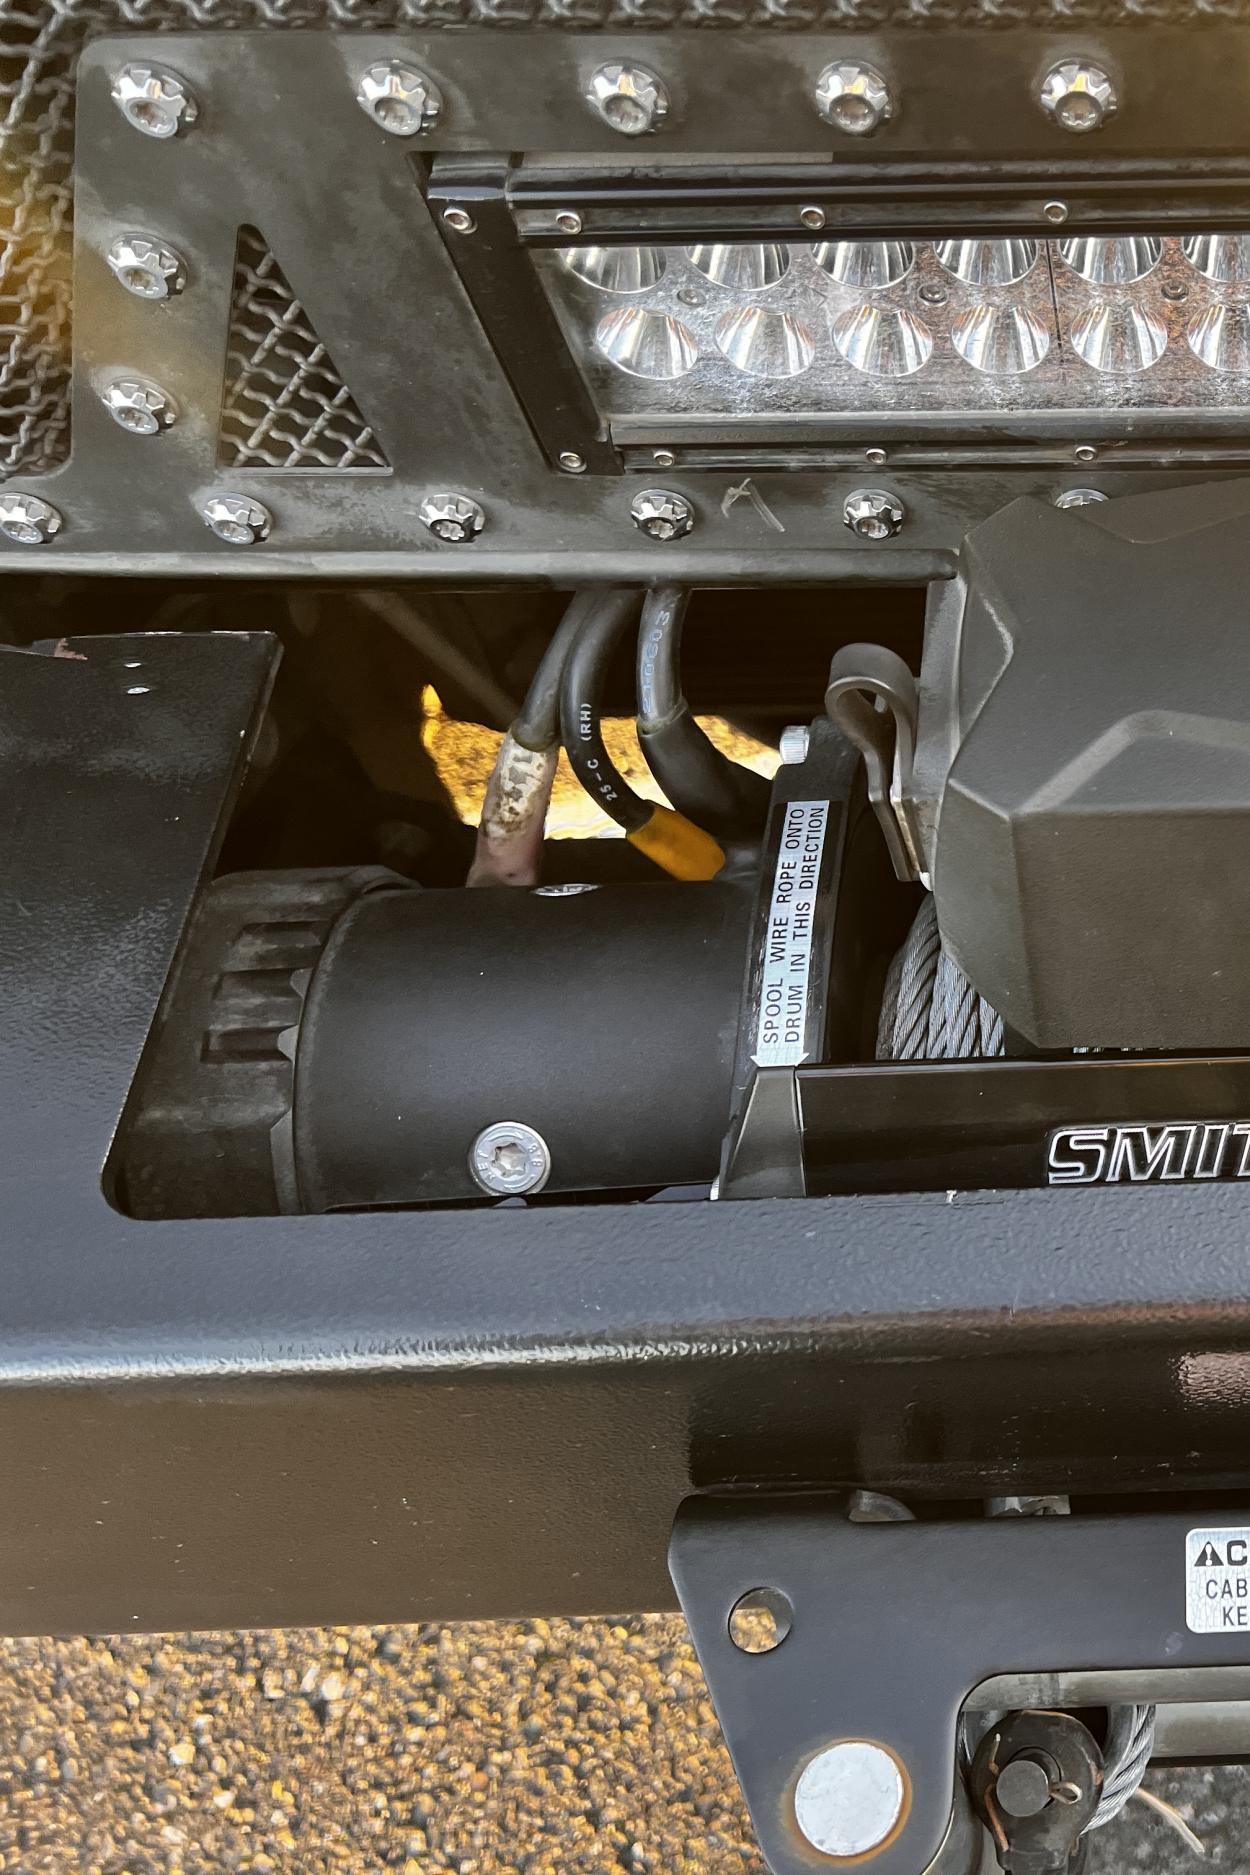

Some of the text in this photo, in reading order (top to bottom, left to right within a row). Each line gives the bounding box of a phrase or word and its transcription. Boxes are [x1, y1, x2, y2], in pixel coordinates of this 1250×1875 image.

[581, 703, 592, 741] (RH)
[763, 808, 805, 1043] SPOOL WIRE ROPE ONTO
[785, 807, 825, 1042] DRUM IN THIS DIRECTION
